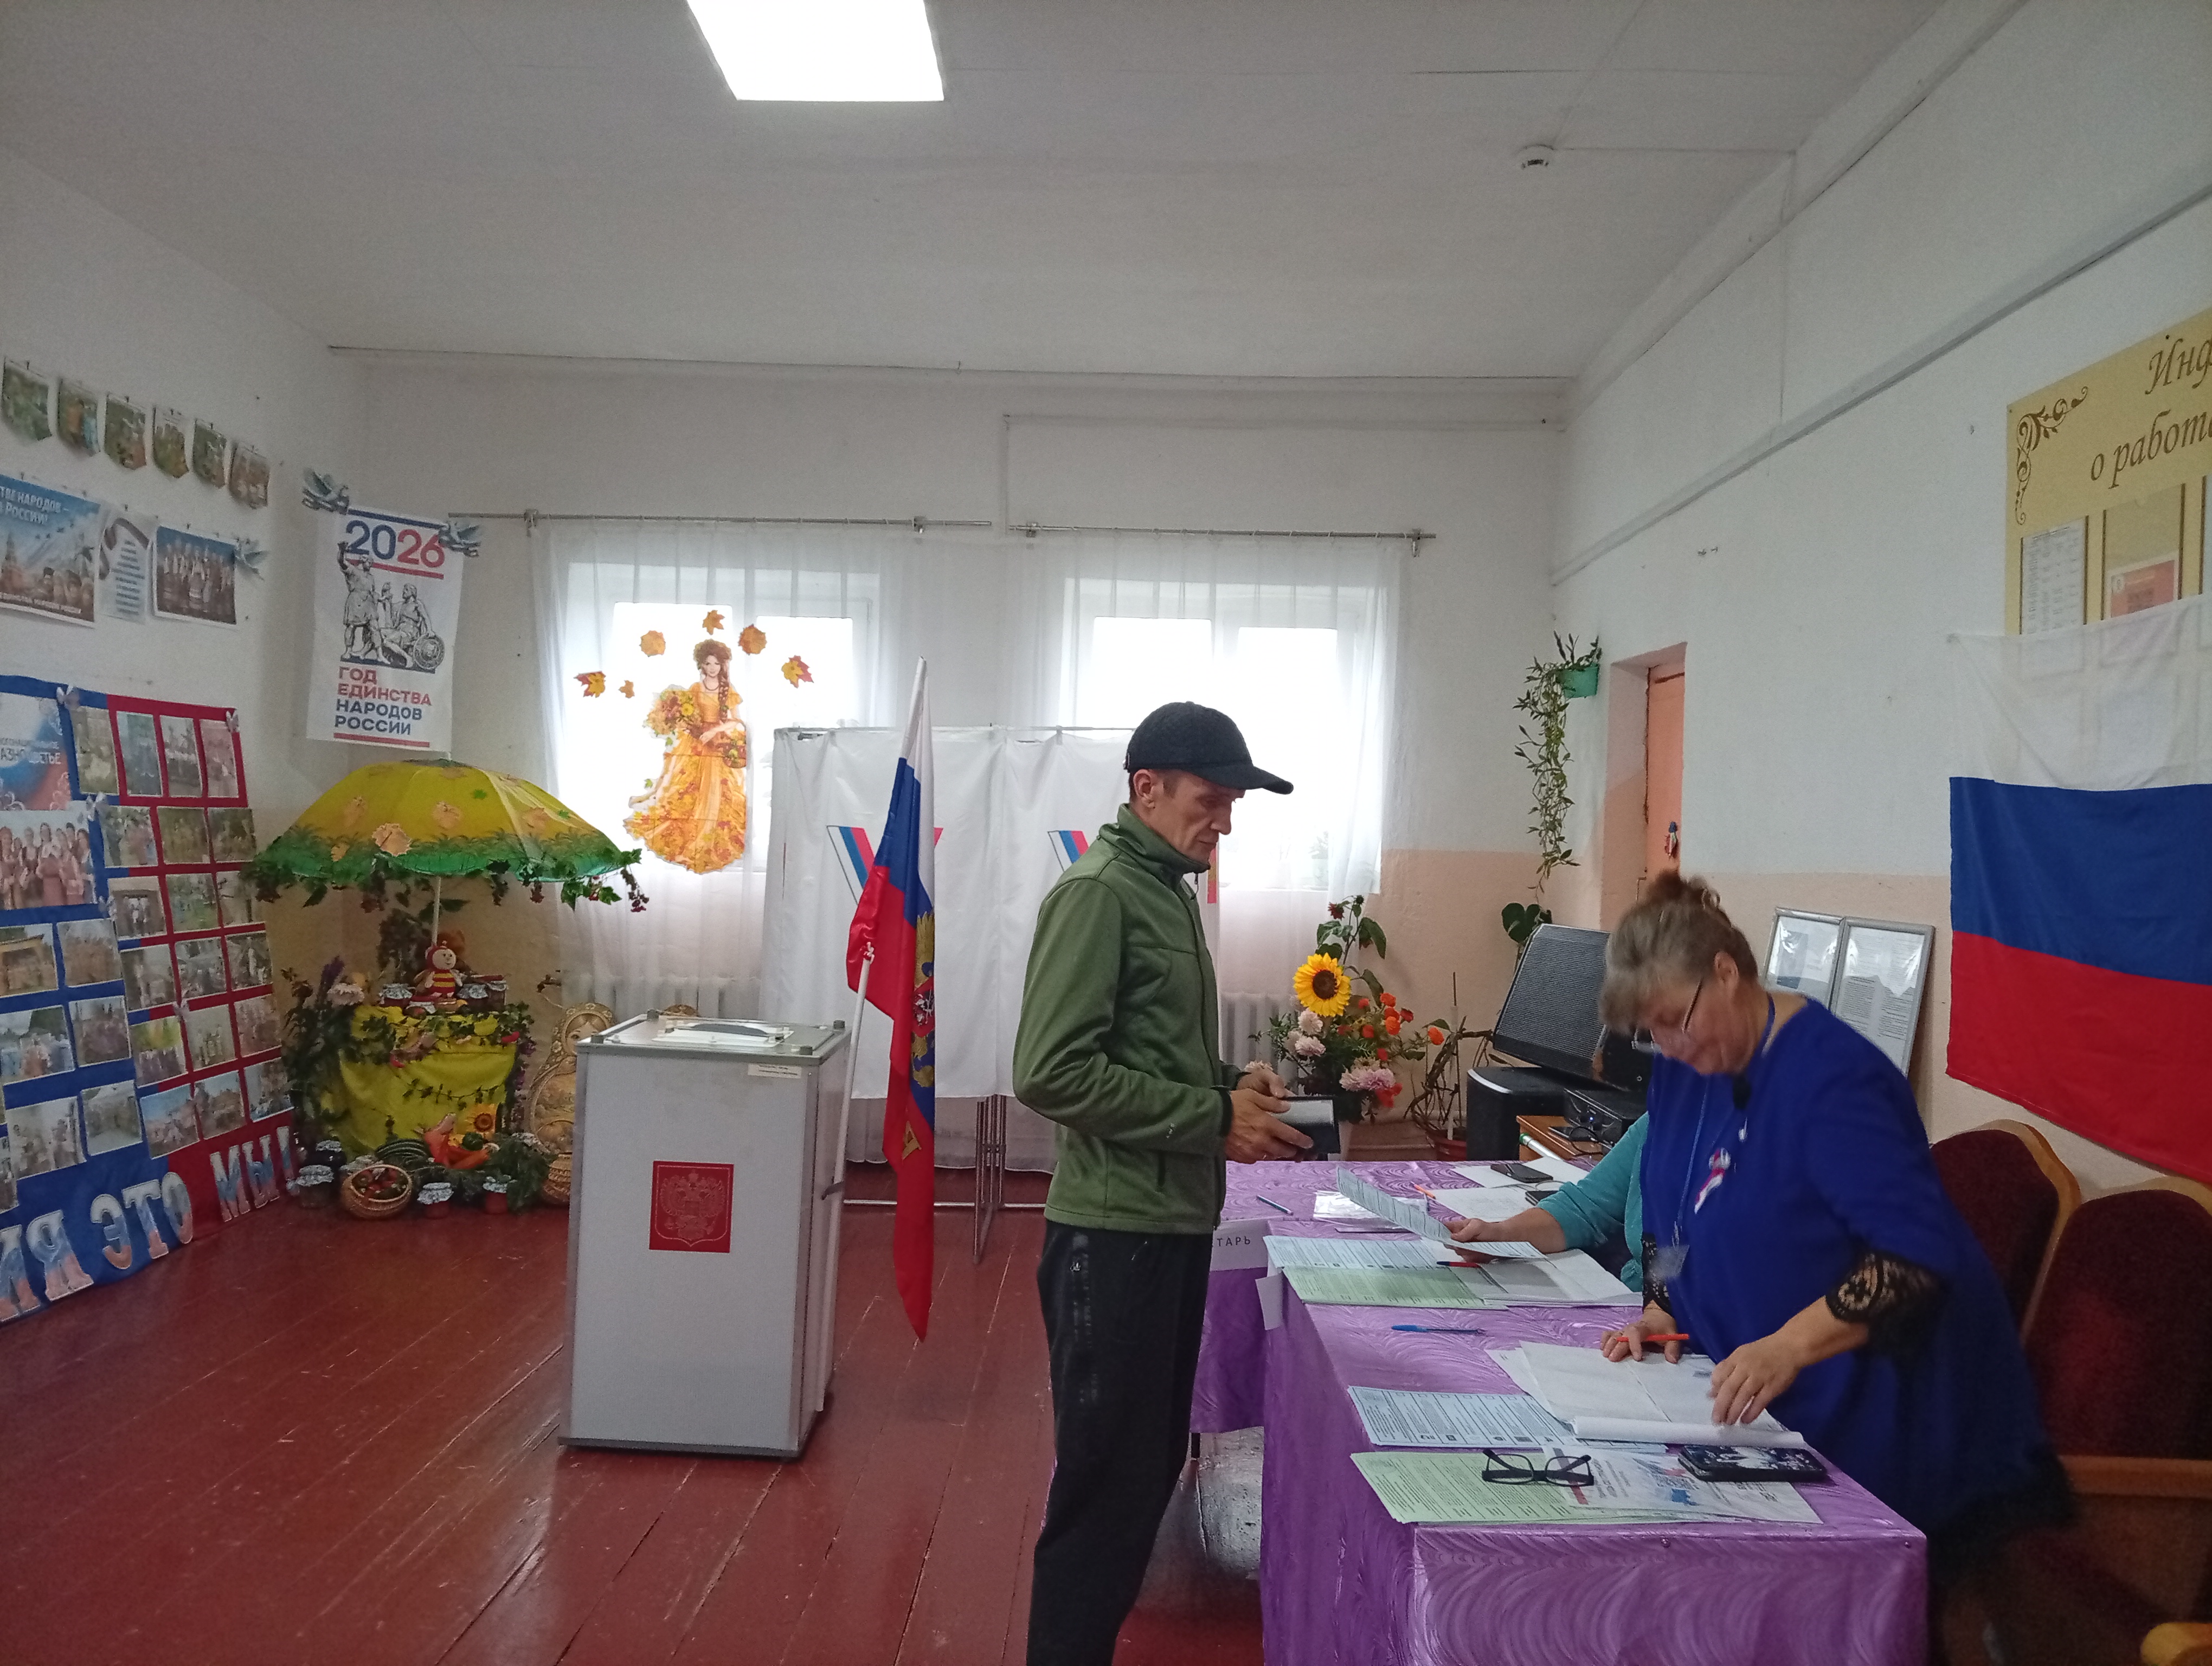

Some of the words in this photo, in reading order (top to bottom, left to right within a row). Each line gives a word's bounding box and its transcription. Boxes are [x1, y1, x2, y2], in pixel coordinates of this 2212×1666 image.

[2091, 453, 2105, 481] о
[17, 491, 61, 513] НАРОДОВ
[345, 520, 445, 568] 2026
[339, 666, 377, 685] ГОД
[338, 683, 432, 706] ЕДИНСТВА
[336, 699, 422, 720] НАРОДОВ
[335, 715, 411, 735] РОССИИ
[90, 1171, 194, 1270] ЭТО
